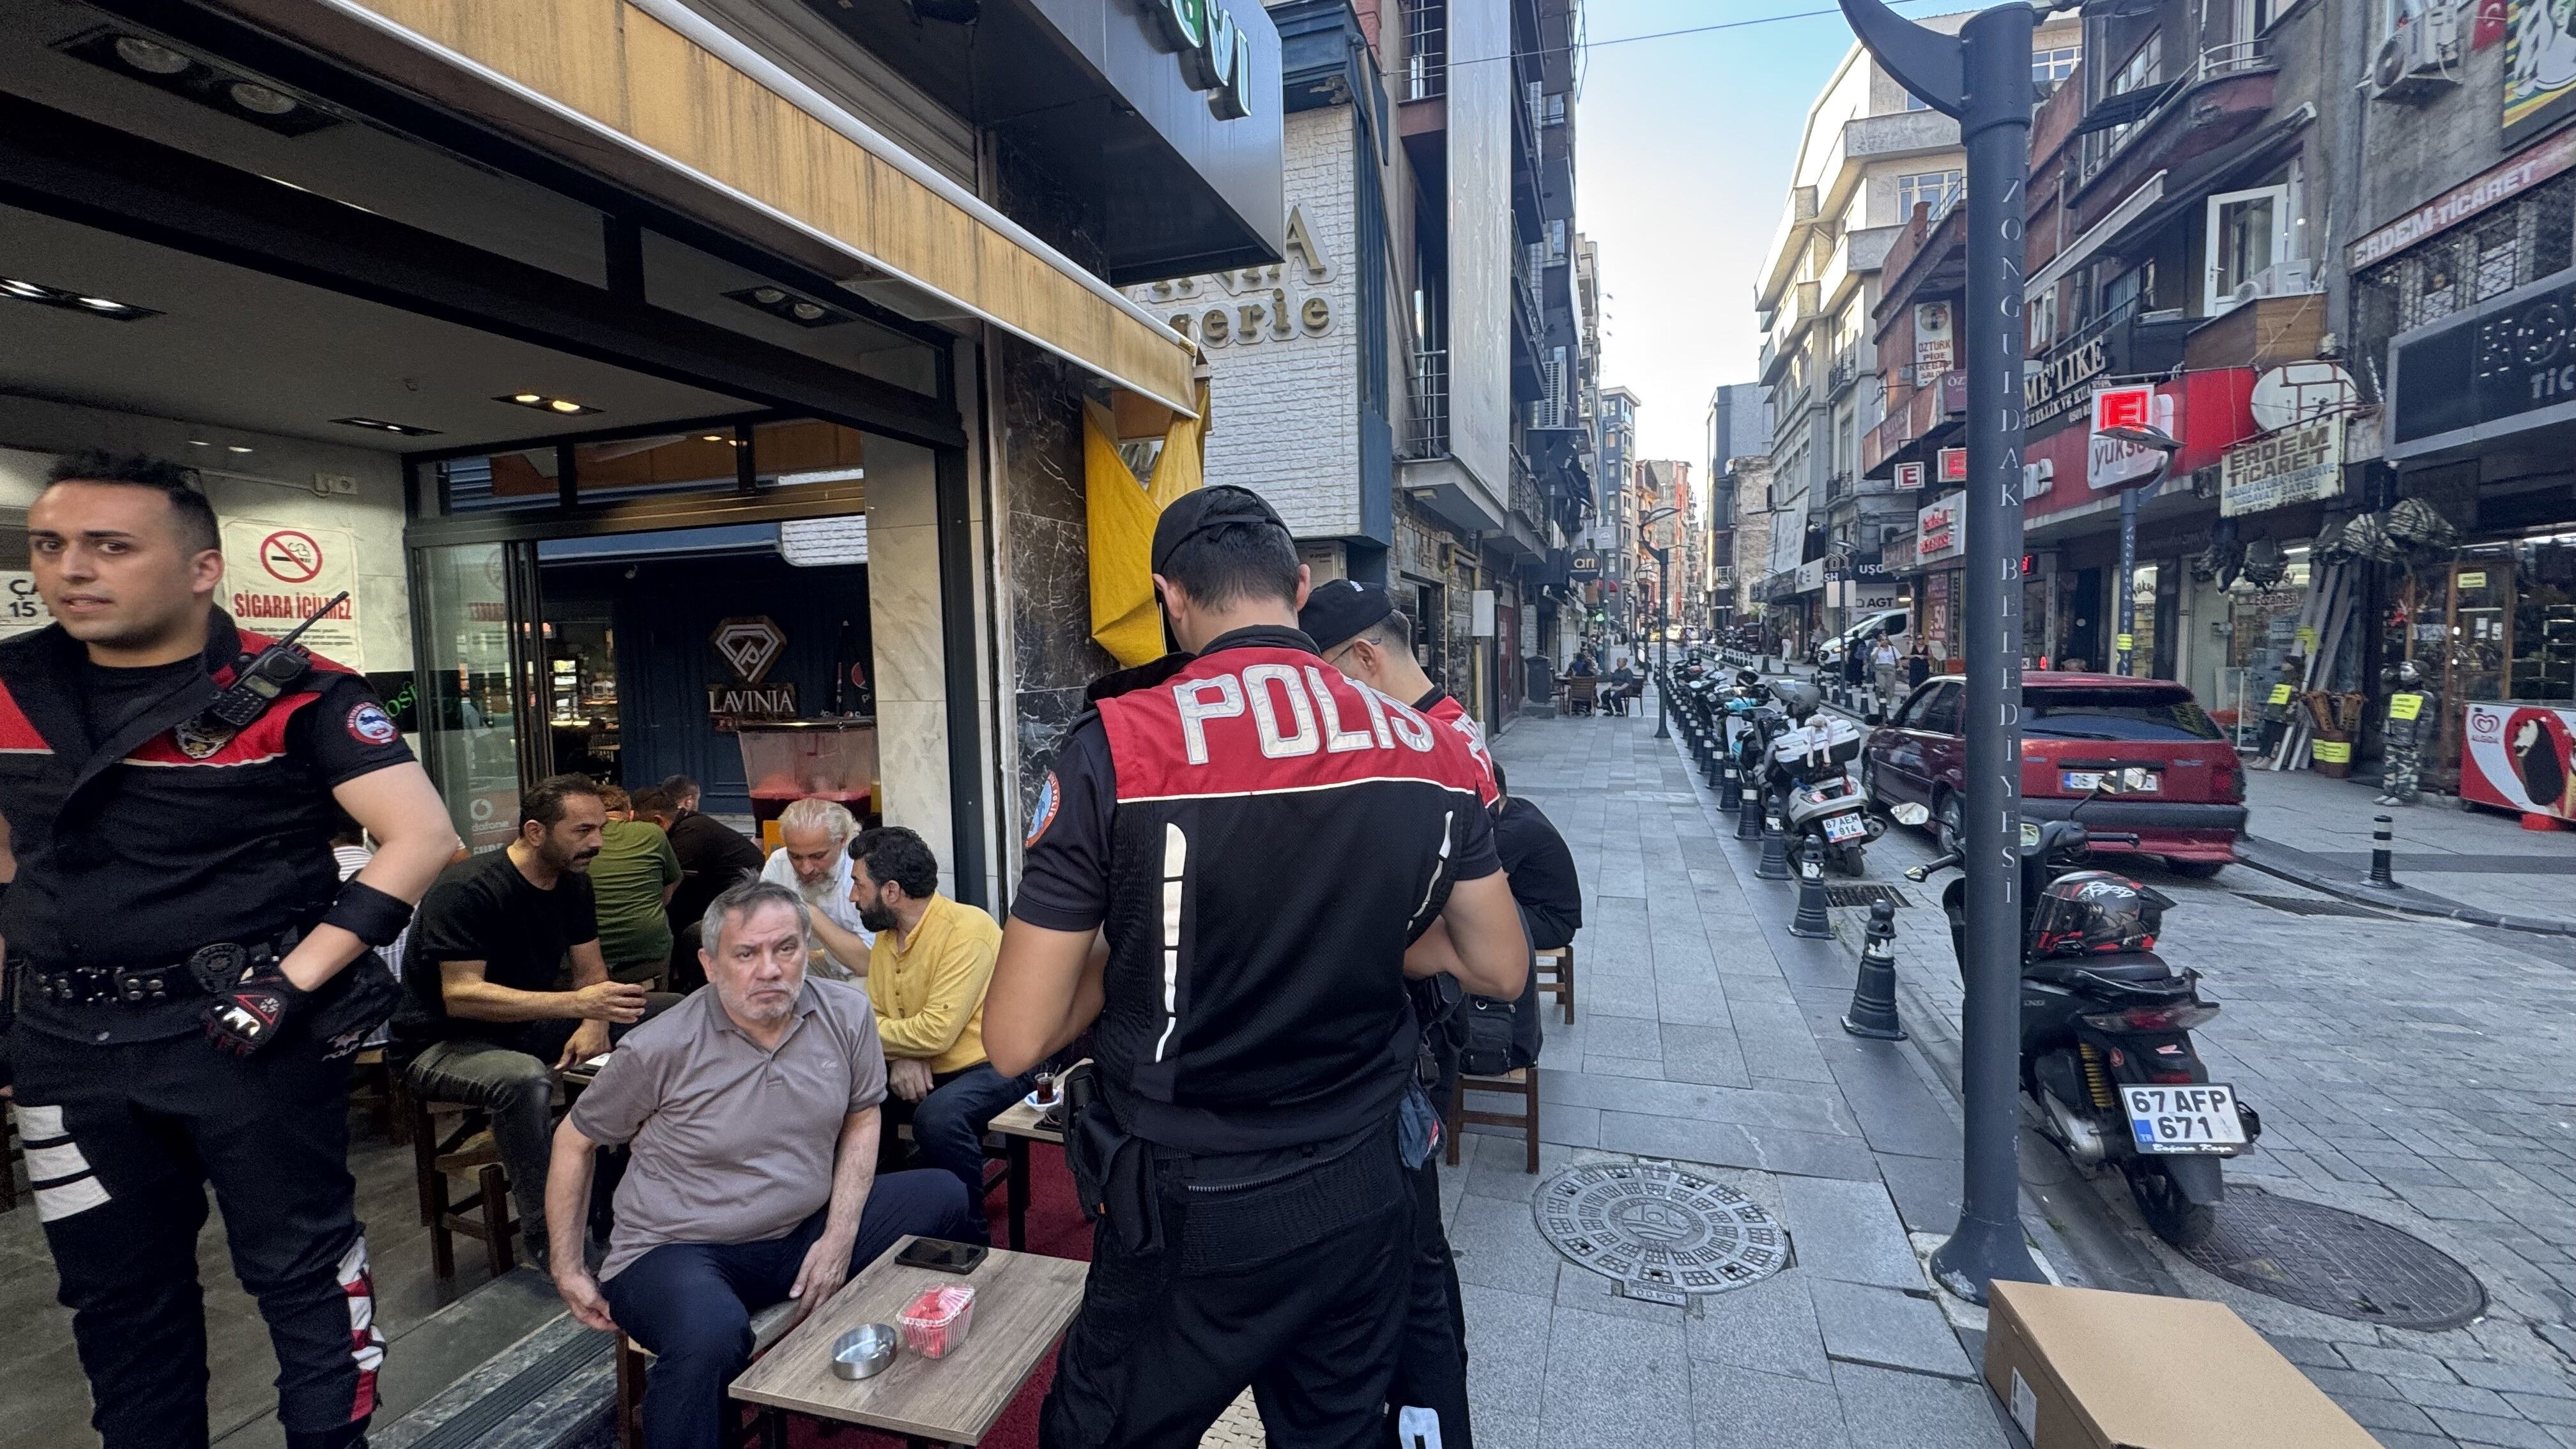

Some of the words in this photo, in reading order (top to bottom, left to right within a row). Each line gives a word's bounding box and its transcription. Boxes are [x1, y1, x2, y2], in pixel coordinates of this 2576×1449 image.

[2000, 178, 2021, 507] ZONGULDAK
[2230, 425, 2330, 470] ERDEM
[1903, 468, 1917, 484] E
[2227, 445, 2331, 487] TİCARET
[9, 602, 37, 617] 15
[234, 590, 293, 618] SİGARA
[1867, 598, 1894, 608] AGT
[708, 690, 795, 713] LAVINIA
[1173, 664, 1435, 765] POLİS
[2000, 558, 2019, 903] BELEDİYESİ
[2131, 1091, 2165, 1112] 67
[2175, 1091, 2226, 1112] AFP
[2158, 1116, 2212, 1138] 671
